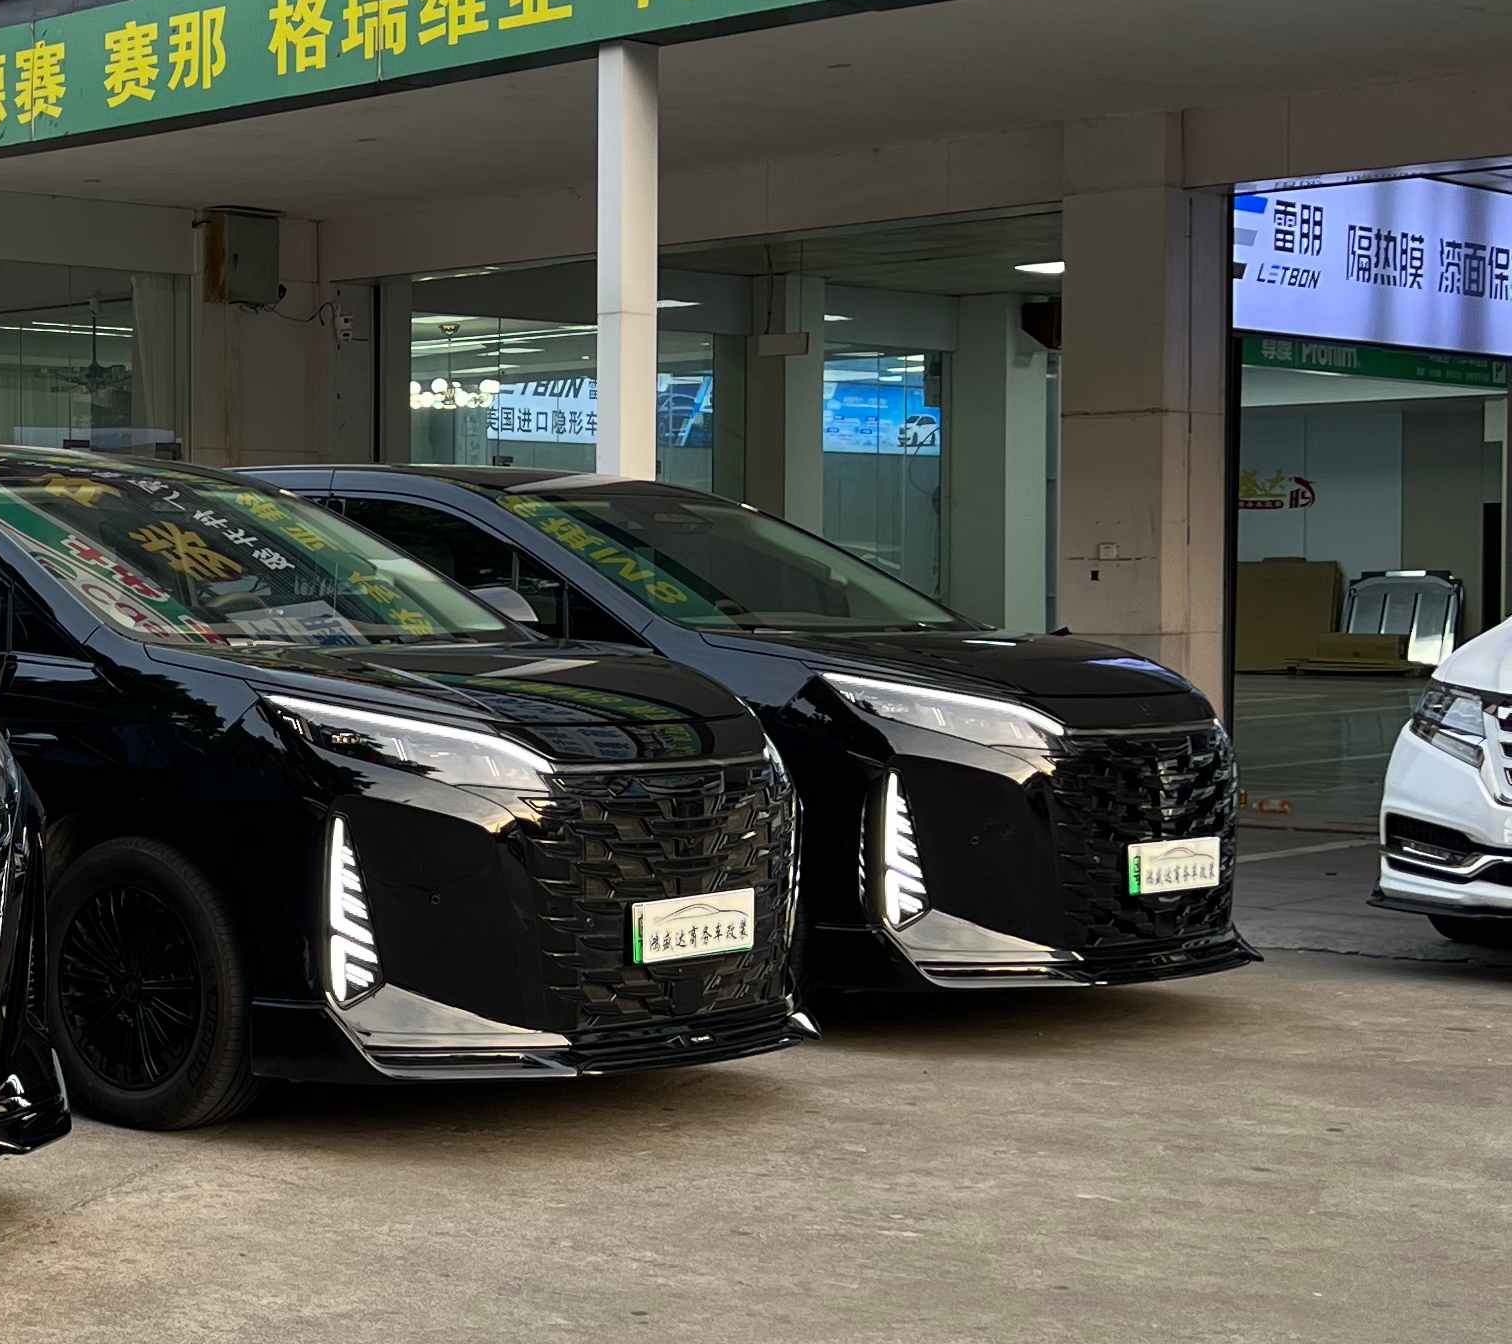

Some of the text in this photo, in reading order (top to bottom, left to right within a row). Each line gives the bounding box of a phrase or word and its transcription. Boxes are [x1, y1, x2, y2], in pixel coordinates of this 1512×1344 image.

[104, 5, 228, 109] 赛那
[1274, 199, 1324, 257] 雷朋
[1346, 223, 1425, 290] 隔热膜
[1256, 262, 1321, 289] LETBON
